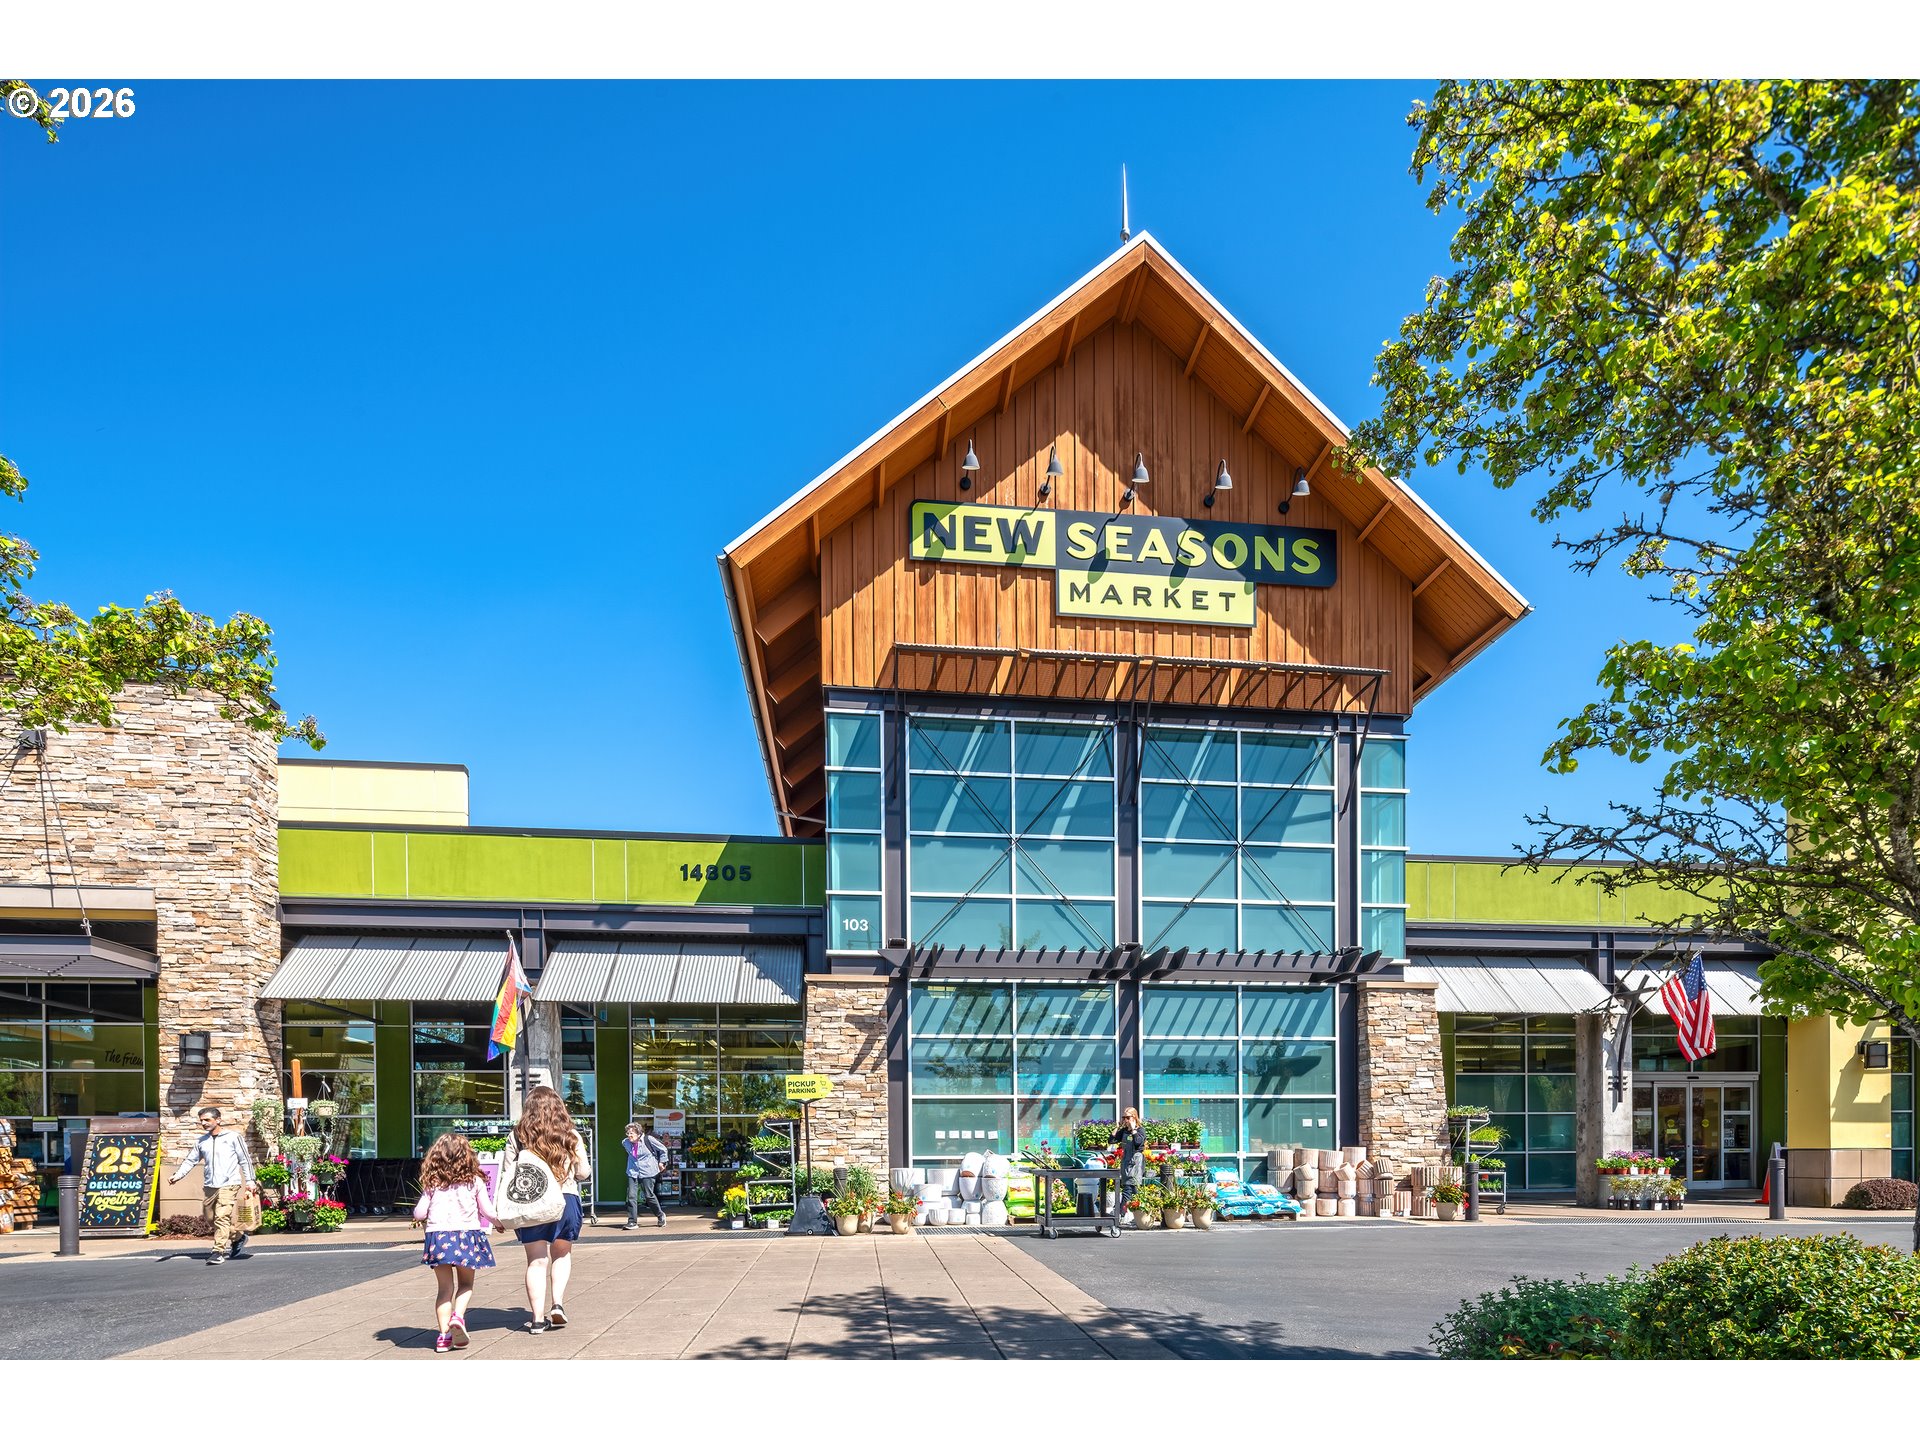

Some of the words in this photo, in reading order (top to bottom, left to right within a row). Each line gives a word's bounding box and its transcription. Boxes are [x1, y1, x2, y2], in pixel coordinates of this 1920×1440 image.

[923, 512, 1044, 555] NEW
[1066, 521, 1321, 575] SEASONS
[1069, 582, 1236, 611] MARKET
[680, 863, 752, 881] 14805
[843, 918, 869, 931] 103
[104, 1049, 121, 1064] The
[788, 1080, 816, 1088] PICKUP
[95, 1146, 144, 1174] 25
[89, 1181, 143, 1190] DELICIOUS
[86, 1191, 141, 1211] Together
